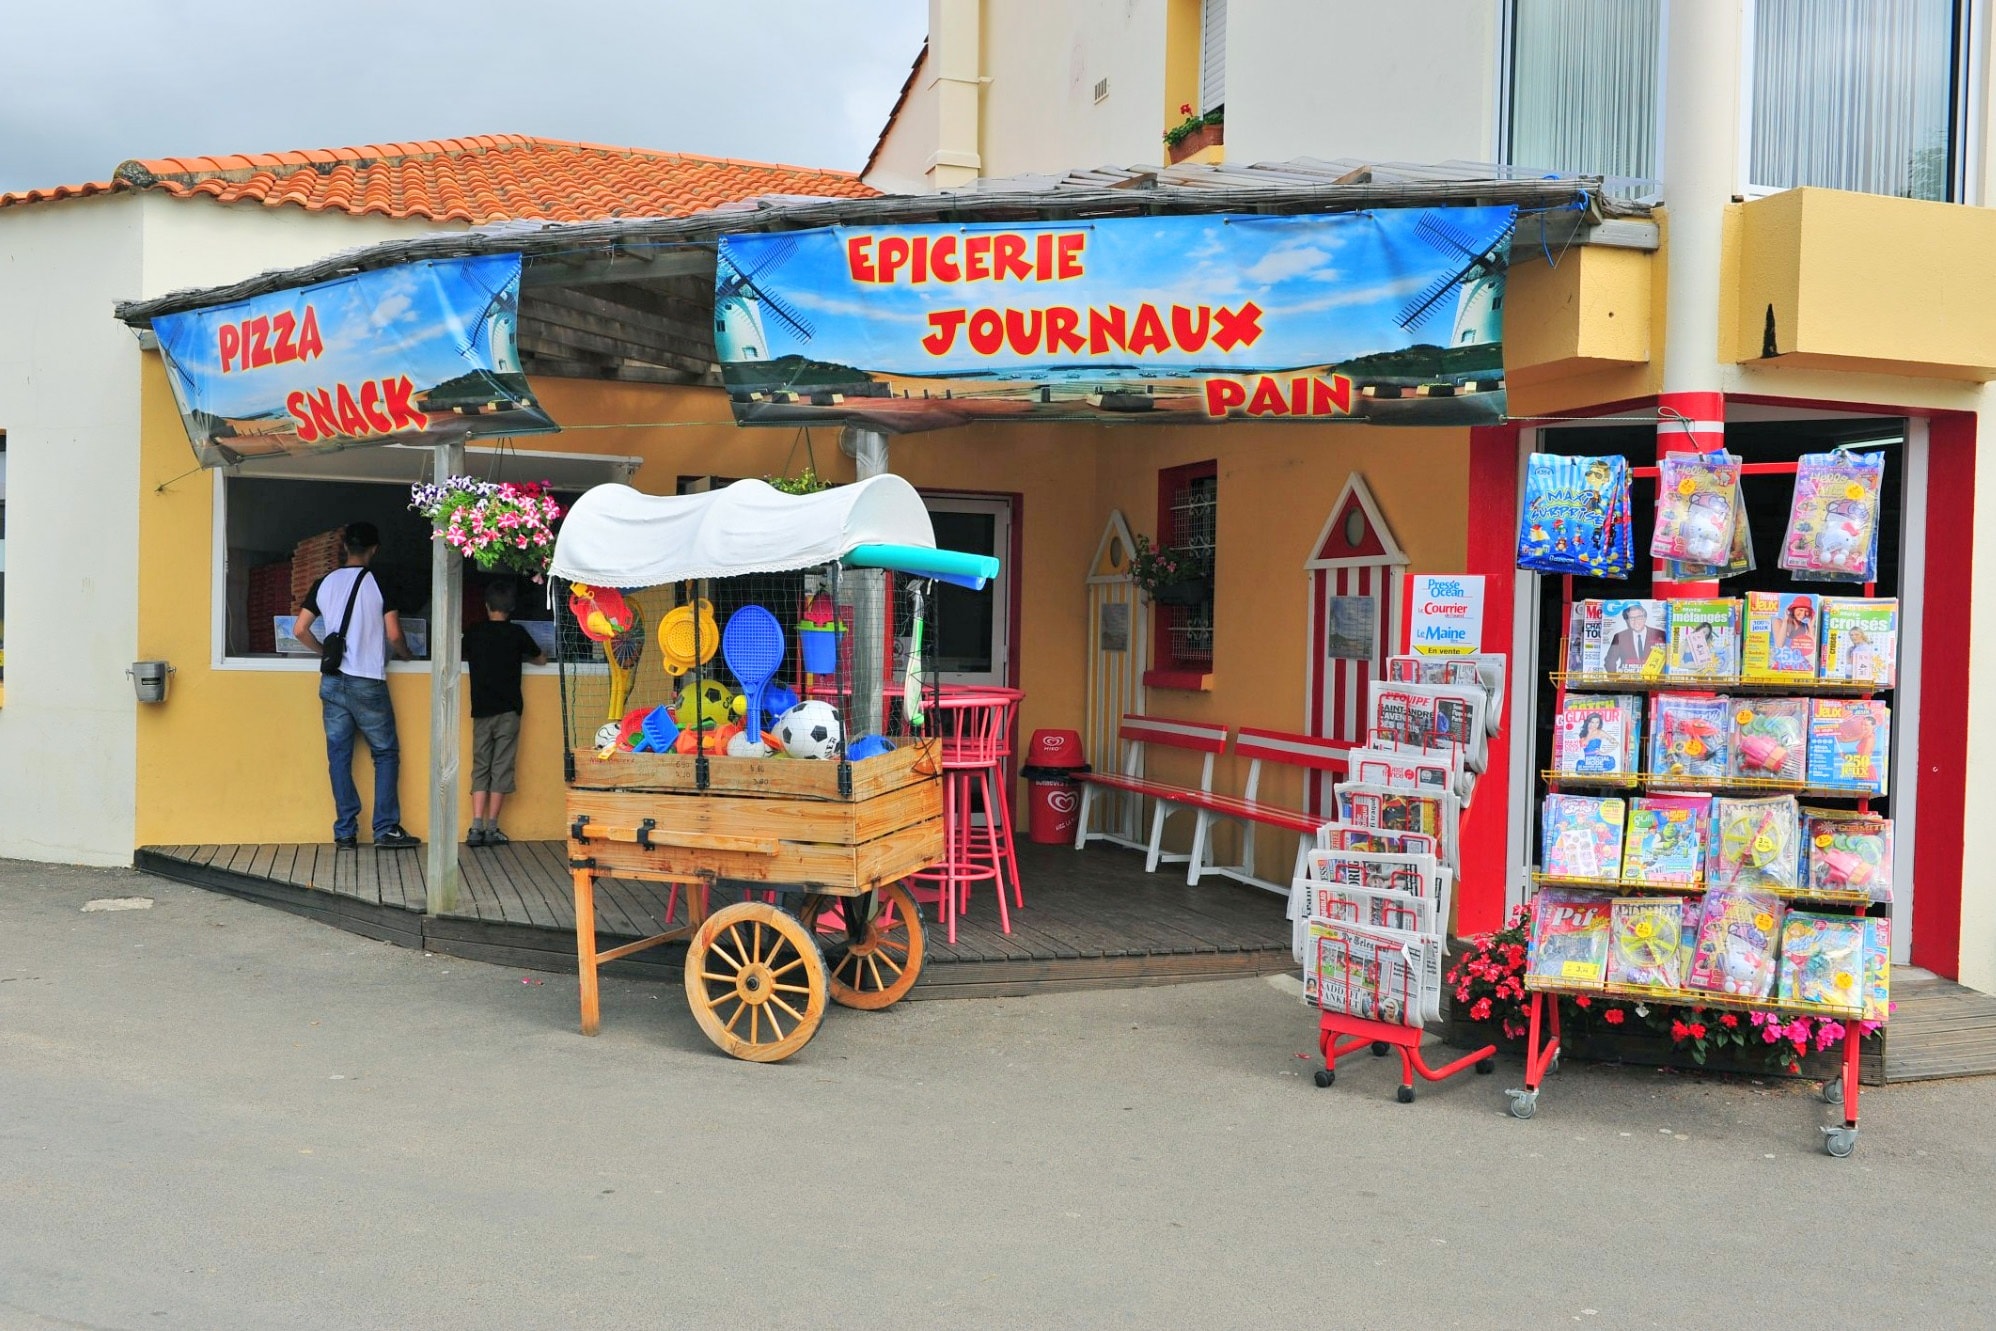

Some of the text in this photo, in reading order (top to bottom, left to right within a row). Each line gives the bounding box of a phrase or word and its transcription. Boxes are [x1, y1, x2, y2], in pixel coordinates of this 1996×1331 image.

[848, 232, 1085, 284] EPICERIE
[218, 304, 325, 374] PIZZA
[922, 301, 1265, 358] JOURNAUX
[1203, 374, 1354, 419] PAIN
[285, 374, 429, 444] SNACK
[1424, 602, 1468, 615] Courrier
[1673, 611, 1728, 623] mélangés
[1425, 626, 1466, 641] Maine
[1829, 617, 1889, 631] croisés
[1844, 755, 1871, 768] 250
[1551, 906, 1599, 927] Pif
